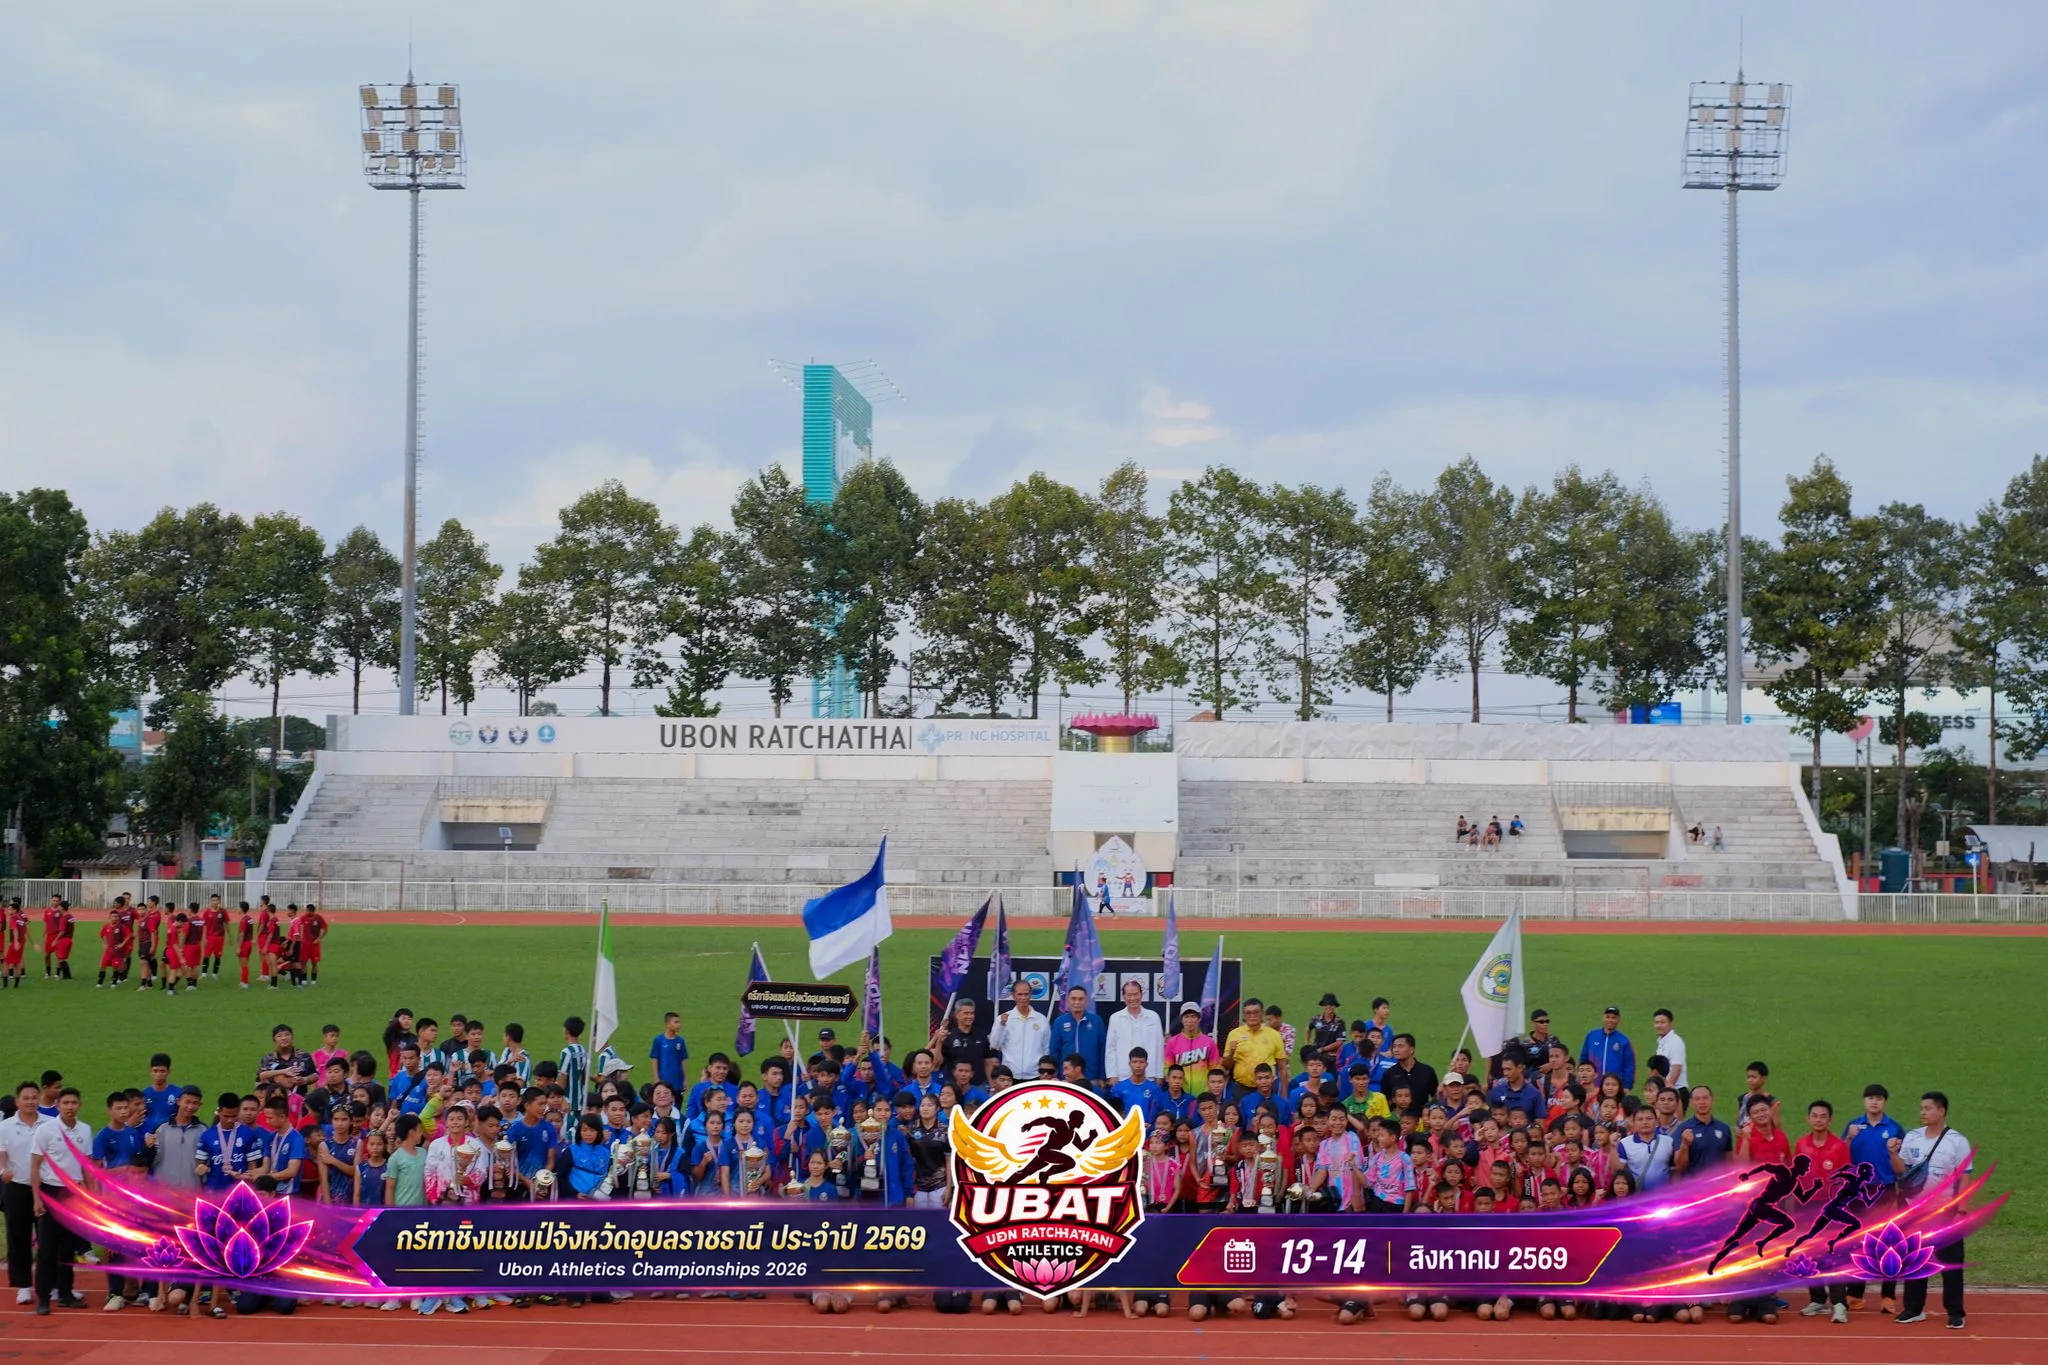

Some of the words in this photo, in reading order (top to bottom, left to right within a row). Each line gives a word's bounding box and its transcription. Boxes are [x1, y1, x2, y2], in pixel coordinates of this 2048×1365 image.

[660, 724, 737, 749] UBON
[750, 725, 912, 750] RATCHATHA
[990, 730, 1051, 742] HOSPITAL
[1175, 1046, 1208, 1066] UBN
